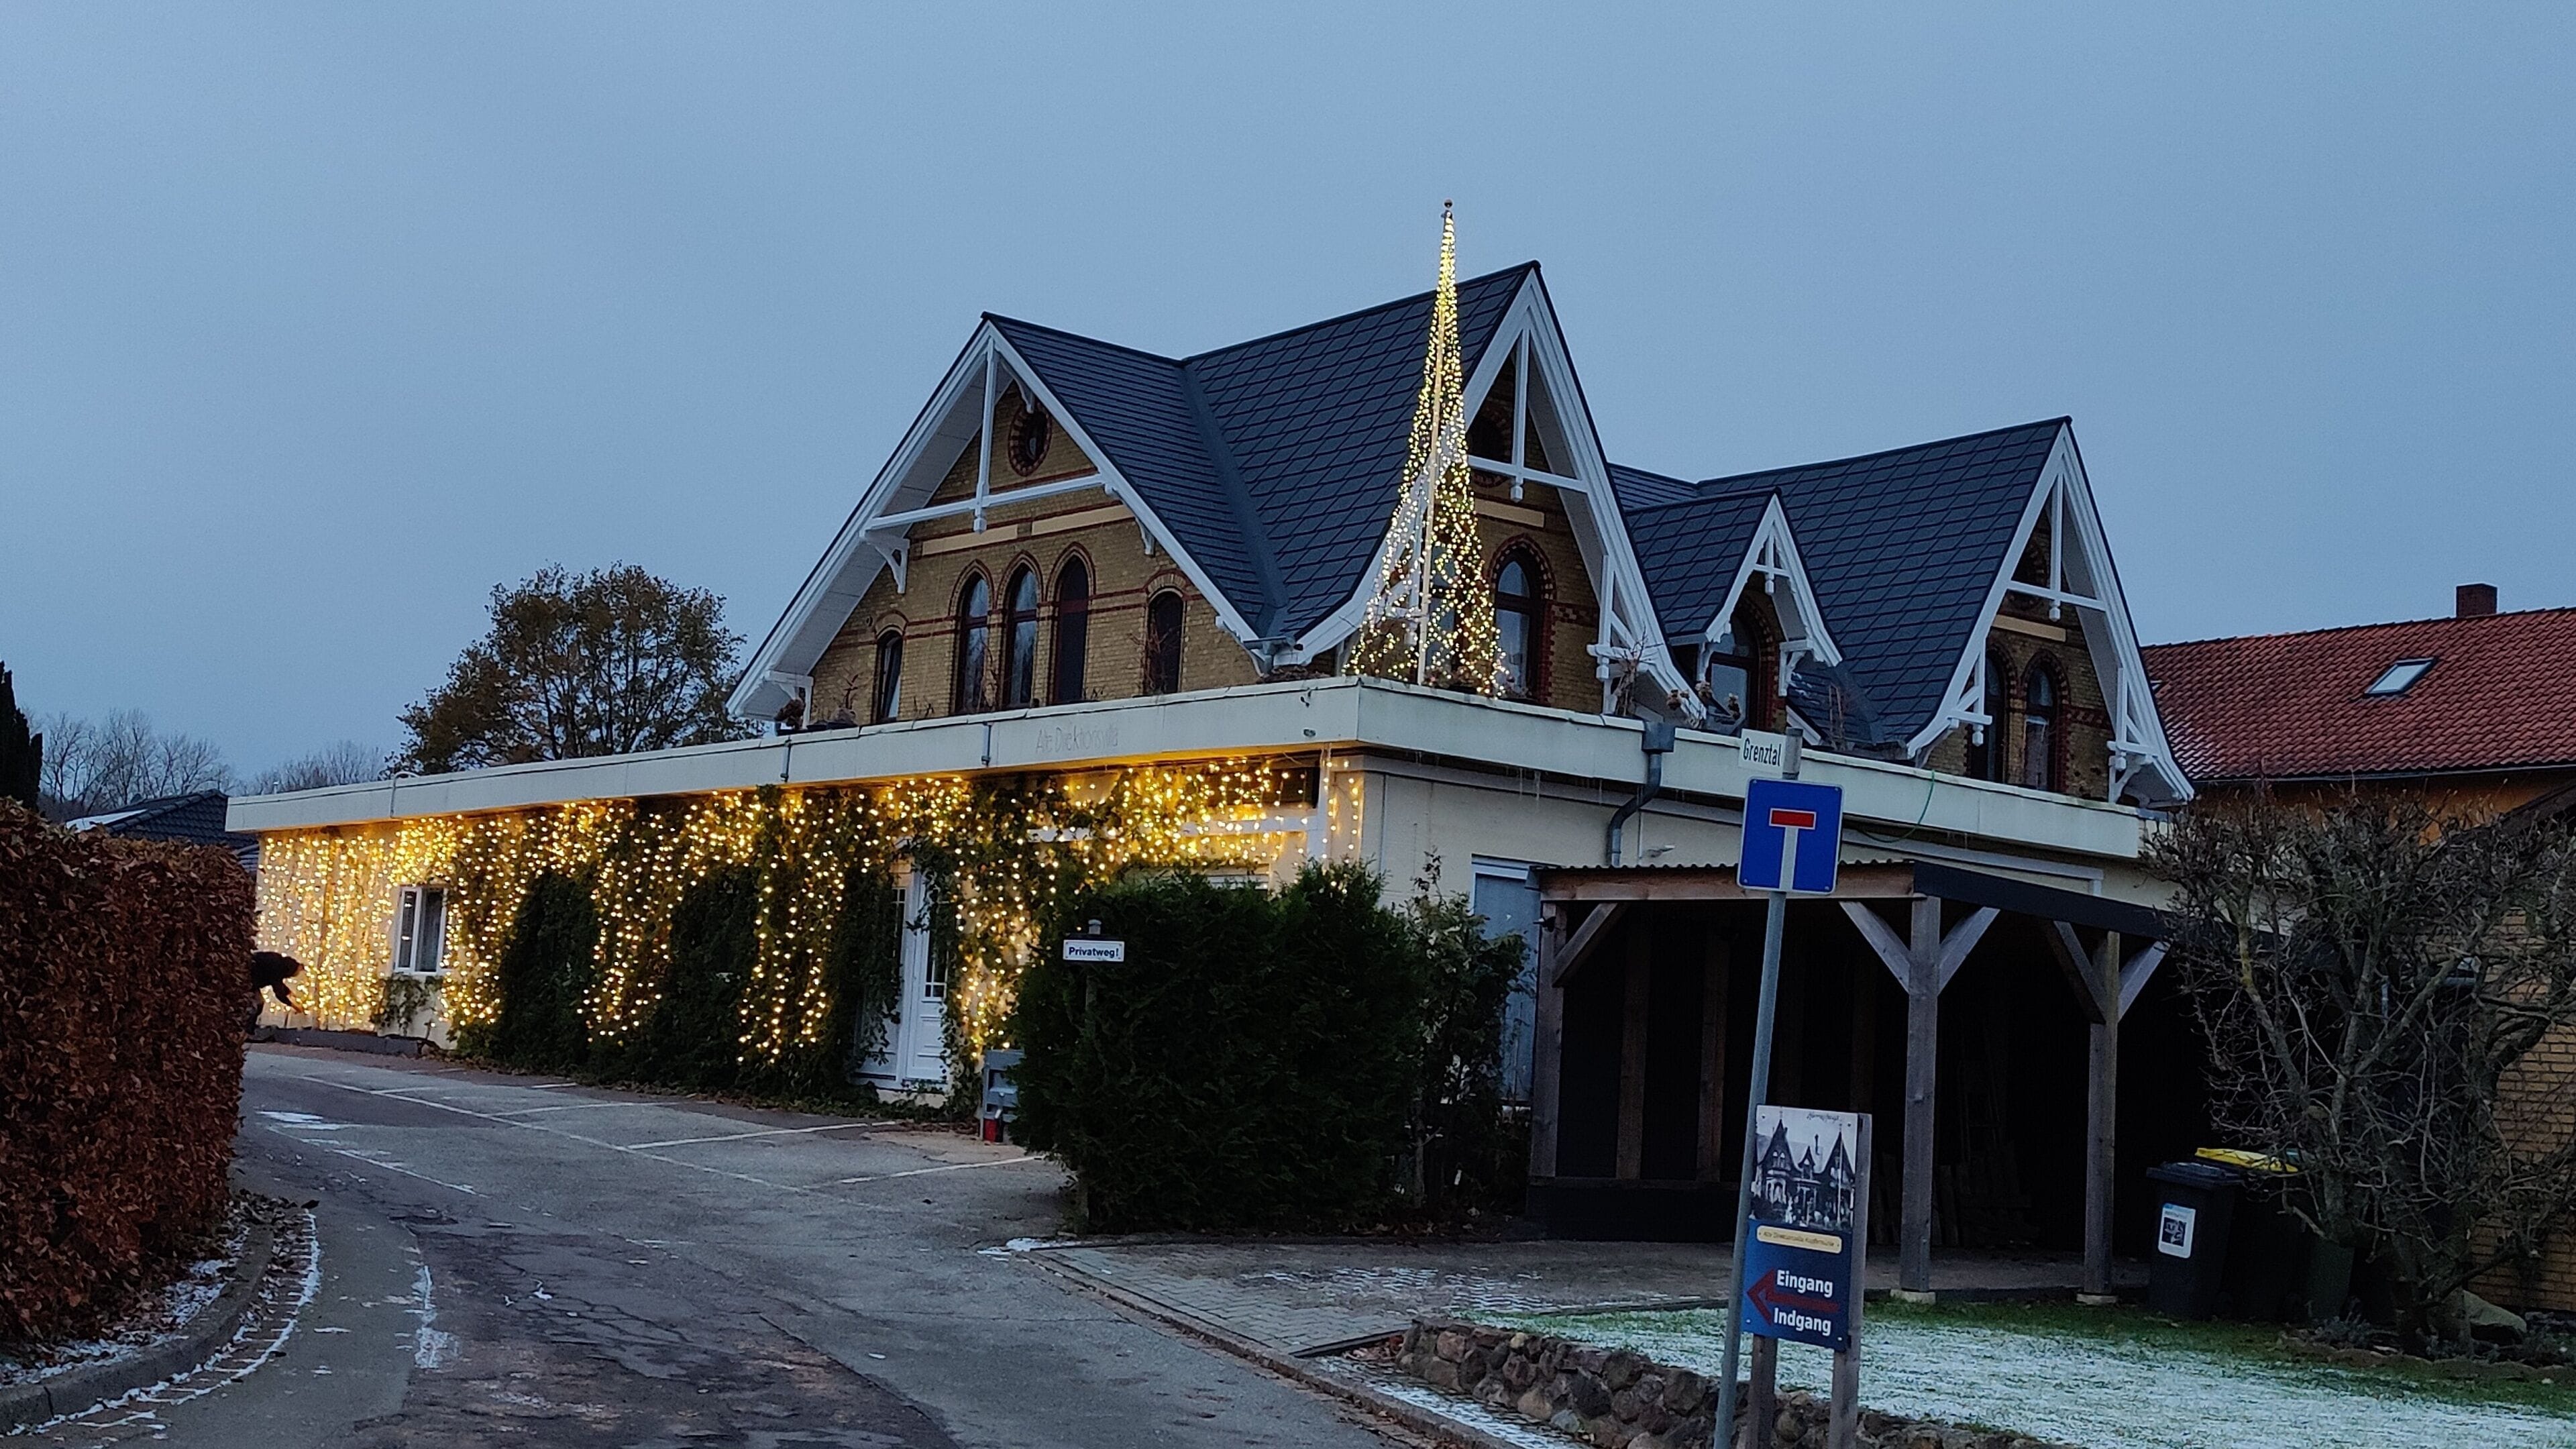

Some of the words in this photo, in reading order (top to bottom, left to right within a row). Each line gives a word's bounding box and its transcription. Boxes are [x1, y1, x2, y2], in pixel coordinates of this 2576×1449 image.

[1743, 738, 1782, 767] Grenztal
[1069, 947, 1119, 958] Privatweg!
[1777, 1269, 1833, 1298] Eingang
[1774, 1307, 1831, 1336] Indgang
